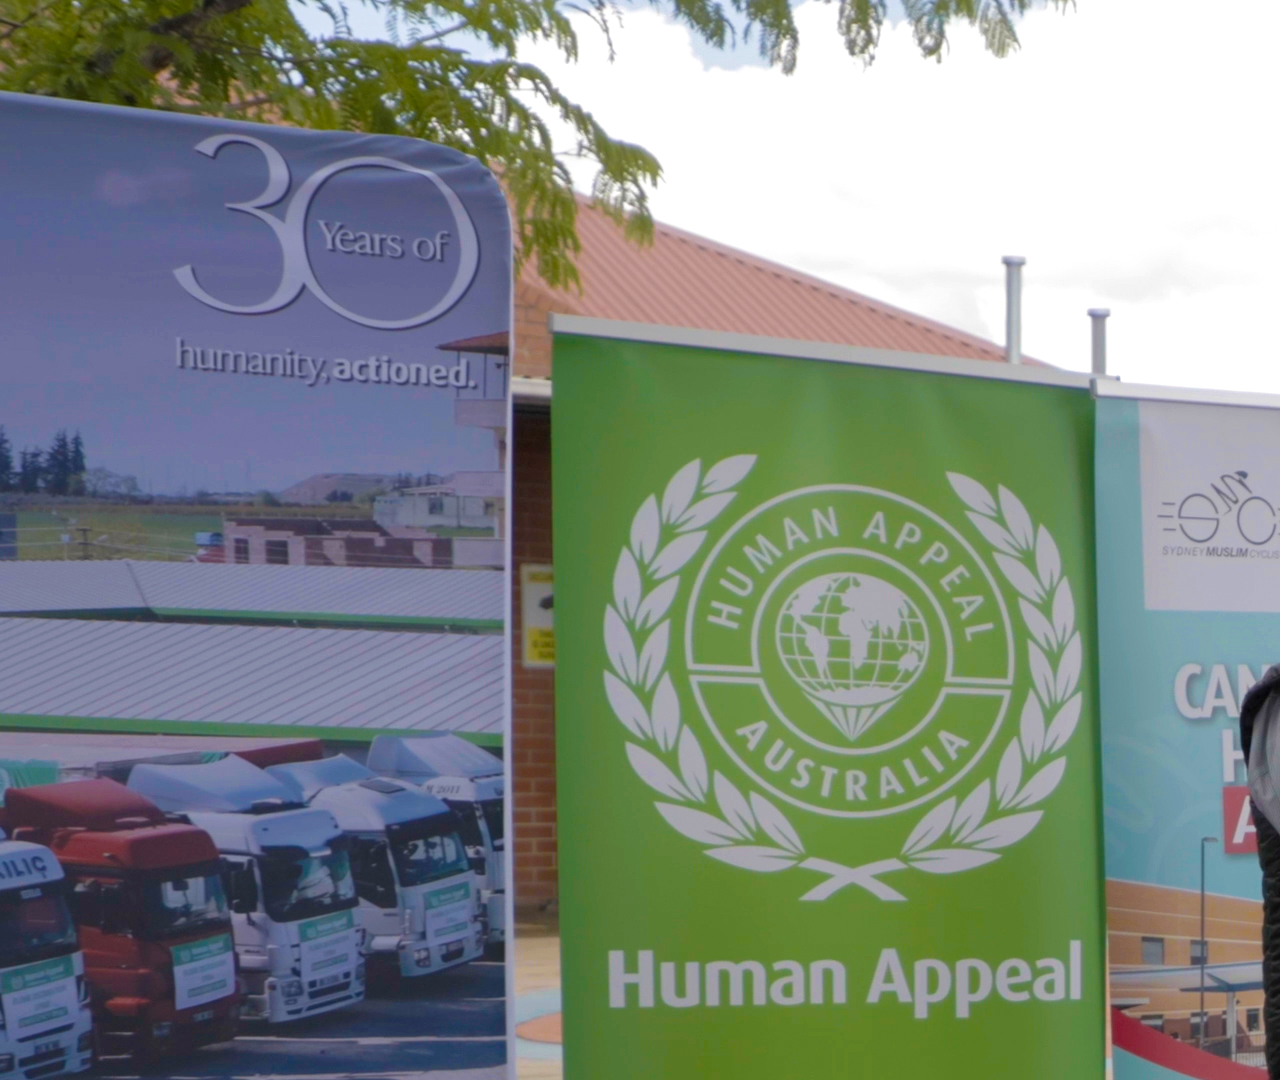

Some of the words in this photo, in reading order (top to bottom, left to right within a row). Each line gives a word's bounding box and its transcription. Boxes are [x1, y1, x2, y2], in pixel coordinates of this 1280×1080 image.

[173, 134, 480, 331] 30
[317, 220, 405, 258] Years
[412, 231, 451, 262] of
[176, 337, 331, 386] humanity,
[333, 355, 478, 388] actioned.
[707, 506, 839, 630] HUMAN
[862, 511, 994, 642] APPEAL
[1162, 546, 1205, 557] SYDNEY
[1206, 546, 1248, 558] MUSLIM
[736, 720, 970, 801] AUSTRALIA
[608, 949, 847, 1008] Human
[866, 940, 1081, 1019] Appeal
